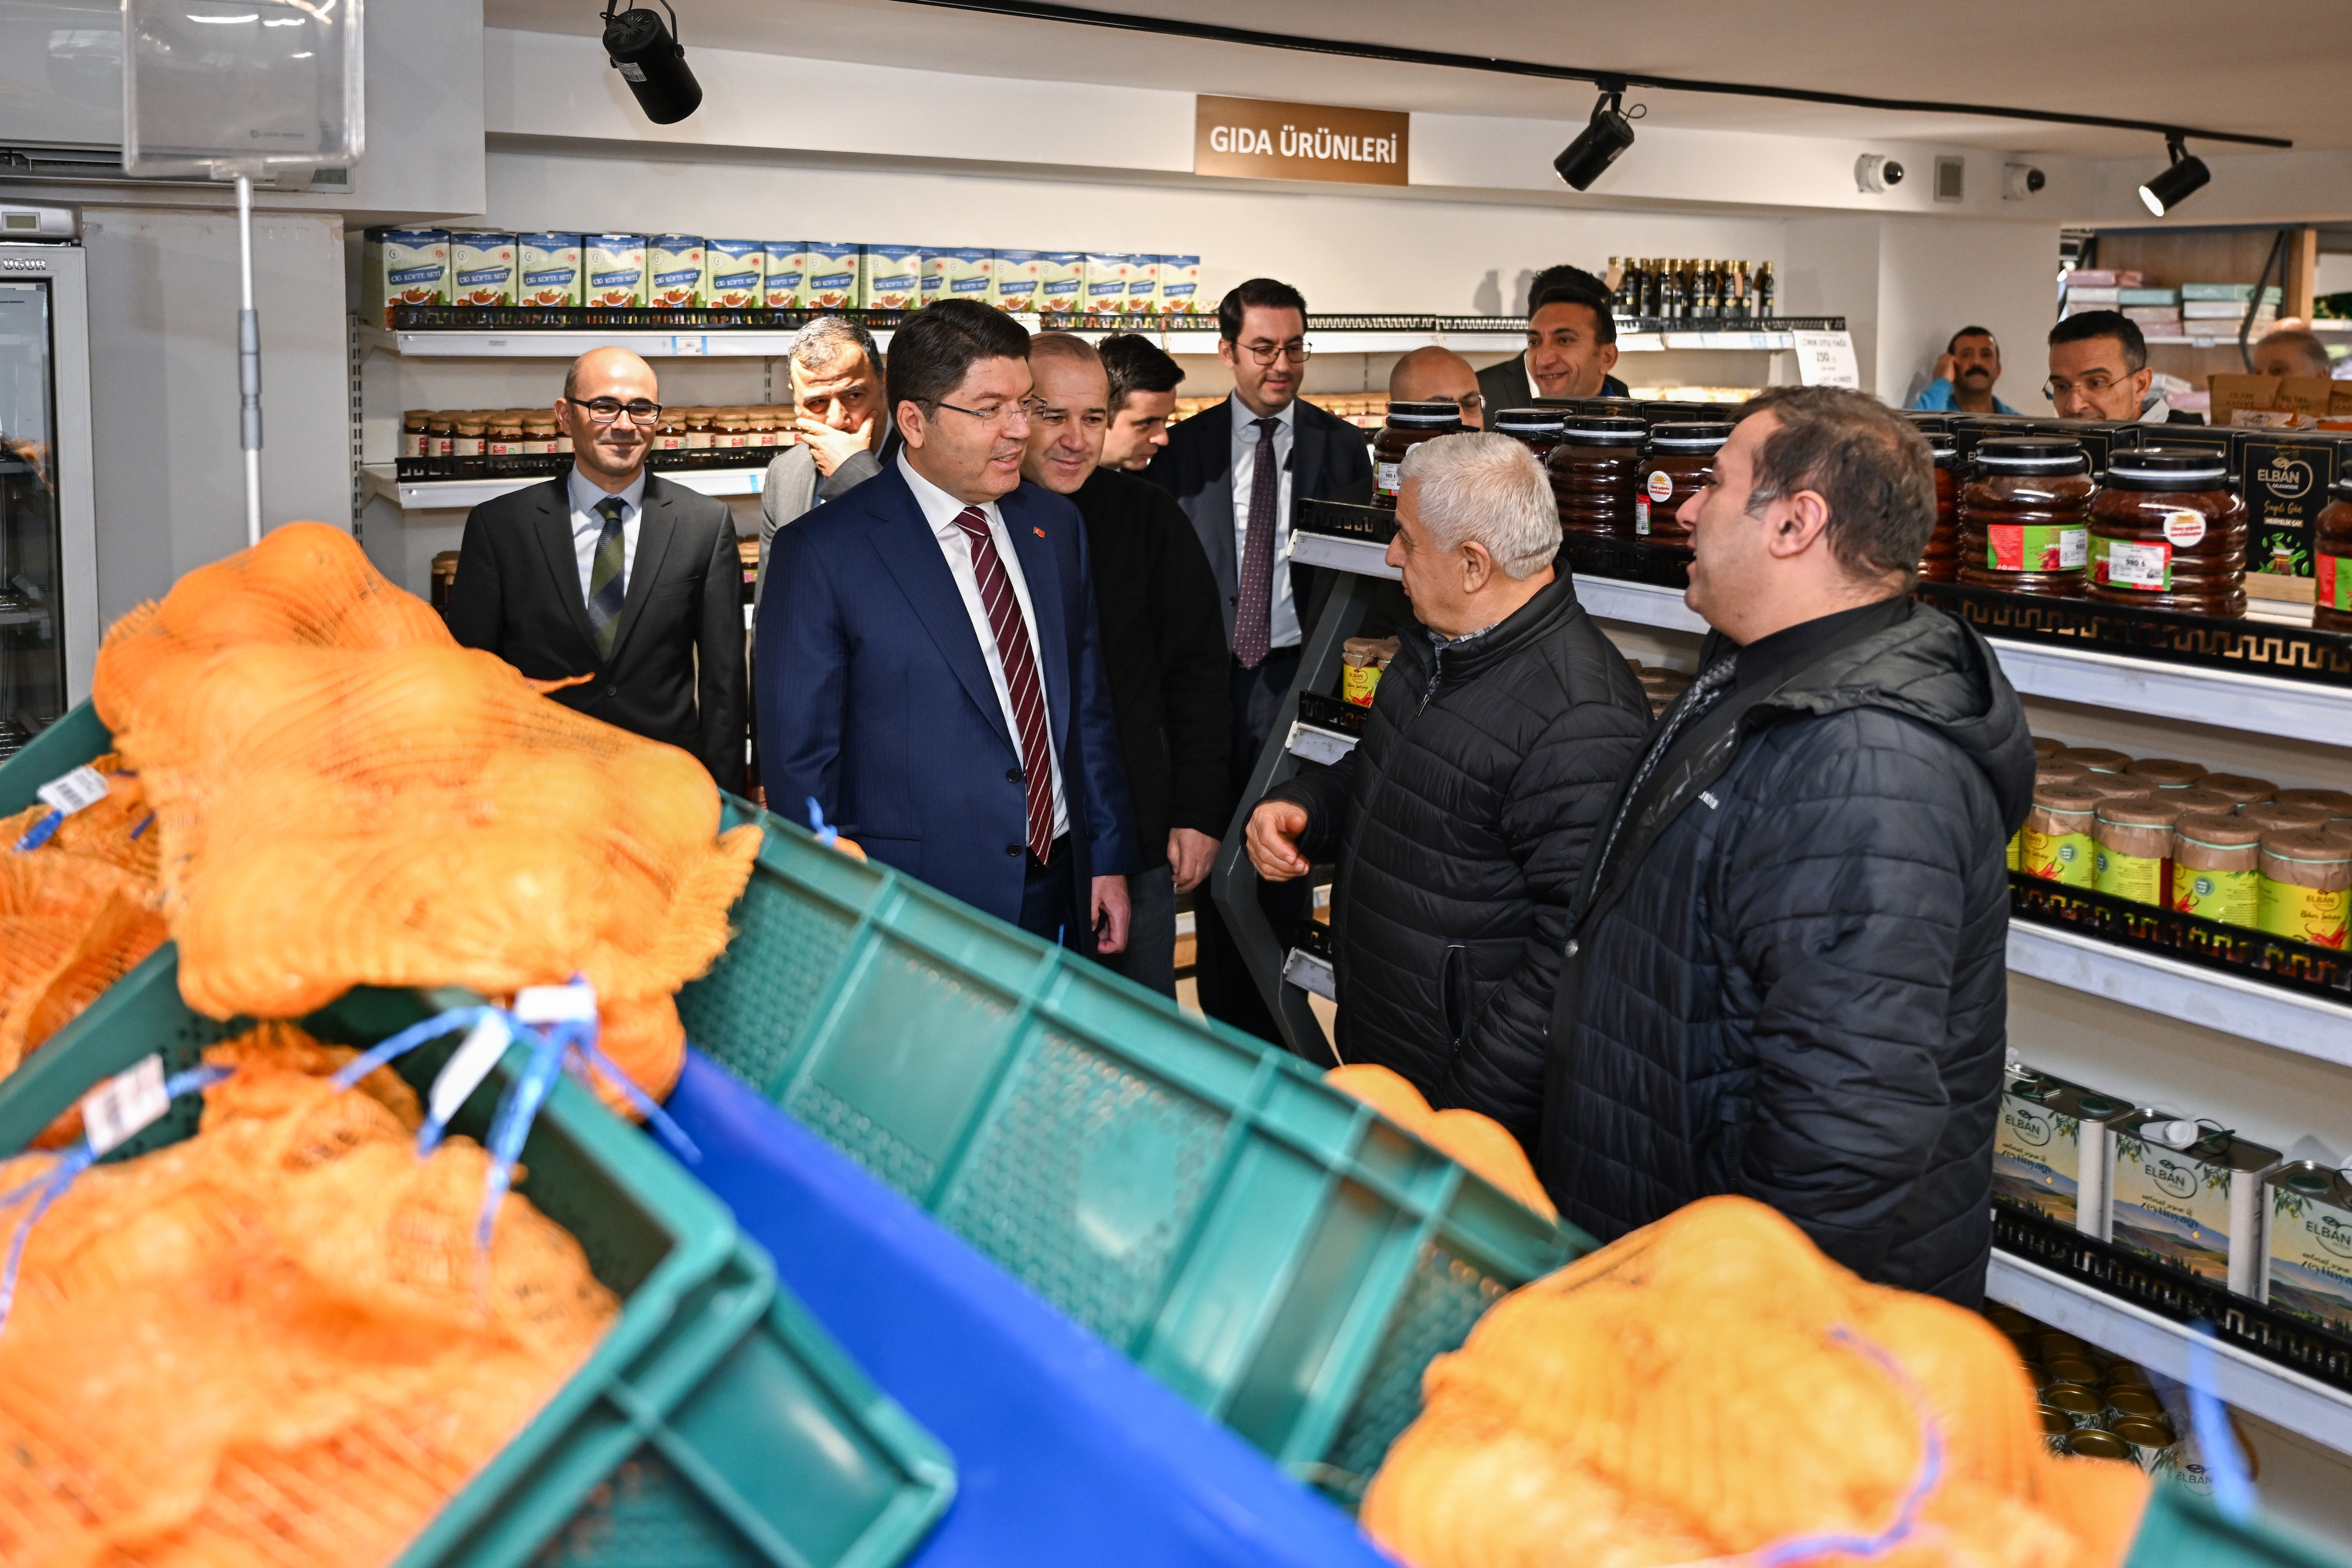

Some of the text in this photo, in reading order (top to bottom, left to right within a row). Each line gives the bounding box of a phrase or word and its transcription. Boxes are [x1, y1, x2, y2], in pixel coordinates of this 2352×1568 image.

[1210, 125, 1397, 164] GIDA ÜRÜNLERİ
[4, 258, 46, 270] UĞUR
[2258, 468, 2300, 483] ELBAN
[2125, 558, 2139, 566] 980
[2005, 1114, 2040, 1135] ELBAN
[2145, 1164, 2185, 1187] ELBAN
[2306, 1221, 2351, 1246] ELBAN
[2176, 1471, 2213, 1485] ELBAN
